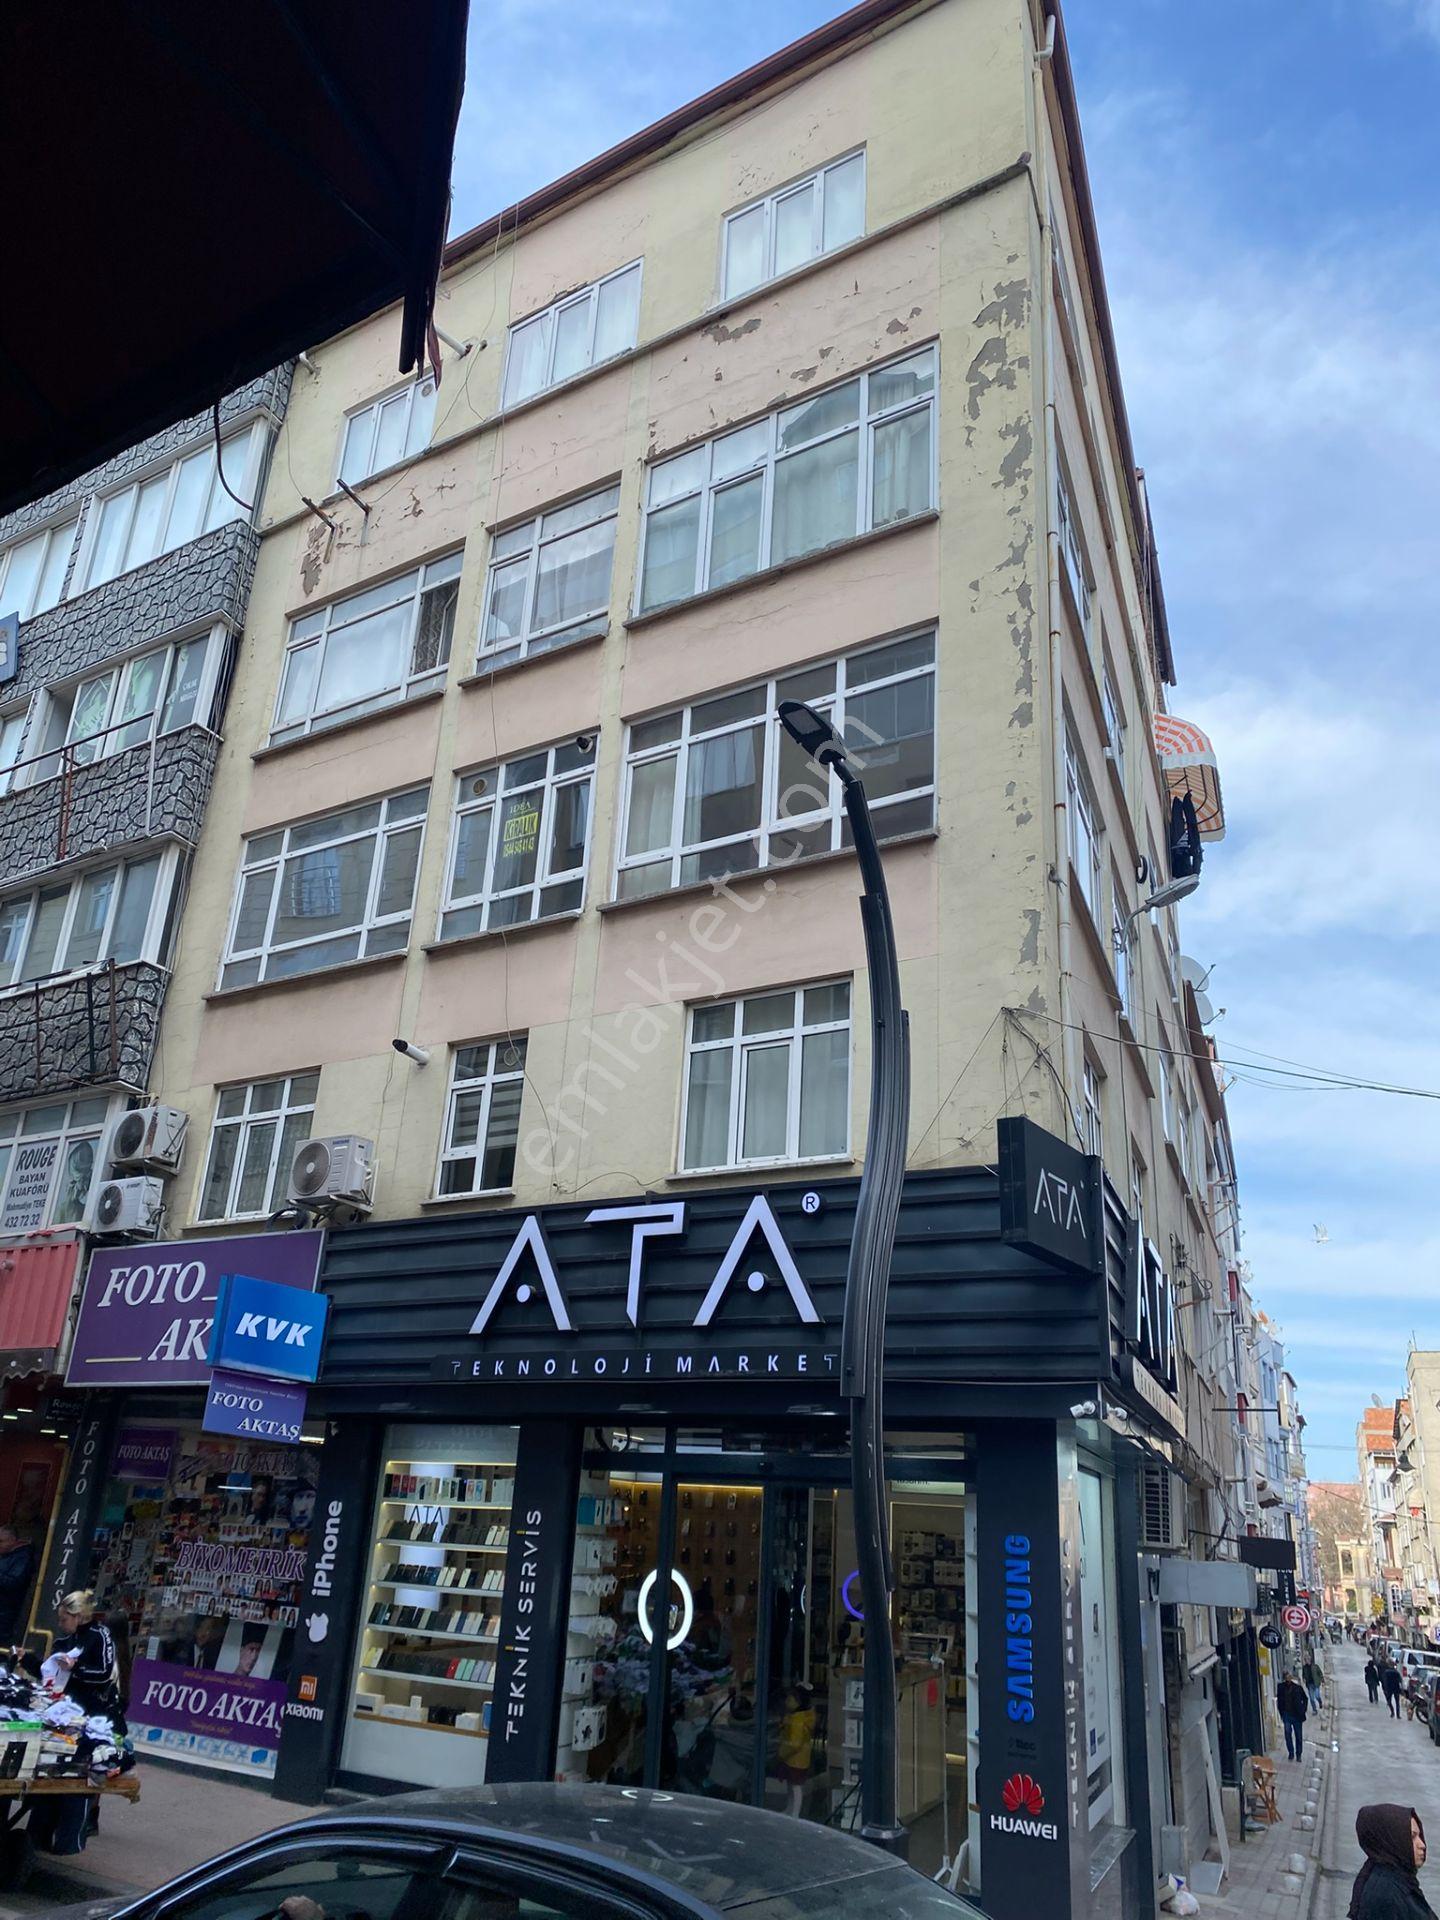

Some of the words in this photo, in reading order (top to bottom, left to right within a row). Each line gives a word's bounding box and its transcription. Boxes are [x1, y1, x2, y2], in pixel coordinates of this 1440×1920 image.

[16, 1145, 58, 1172] ROUGE
[19, 1173, 46, 1185] BAYAN
[97, 1260, 207, 1308] FOTO
[468, 1194, 821, 1335] ATA
[235, 1311, 313, 1347] KVK
[450, 1352, 653, 1377] TEKNOLOJİ
[676, 1353, 839, 1375] MARKET
[212, 1391, 263, 1412] FOTO
[237, 1417, 300, 1440] AKTAŞ
[75, 1421, 99, 1495] FOTO
[117, 1445, 142, 1460] FOTO
[52, 1508, 79, 1609] AKTAŞ
[175, 1535, 308, 1581] BİYOMETRİK
[312, 1500, 342, 1597] iPhone
[517, 1510, 541, 1614] SERVİS
[1004, 1535, 1035, 1723] SAMSUNG
[142, 1680, 208, 1714] FOTO
[505, 1625, 532, 1743] TEKNİK
[990, 1814, 1058, 1841] HUAWEI
